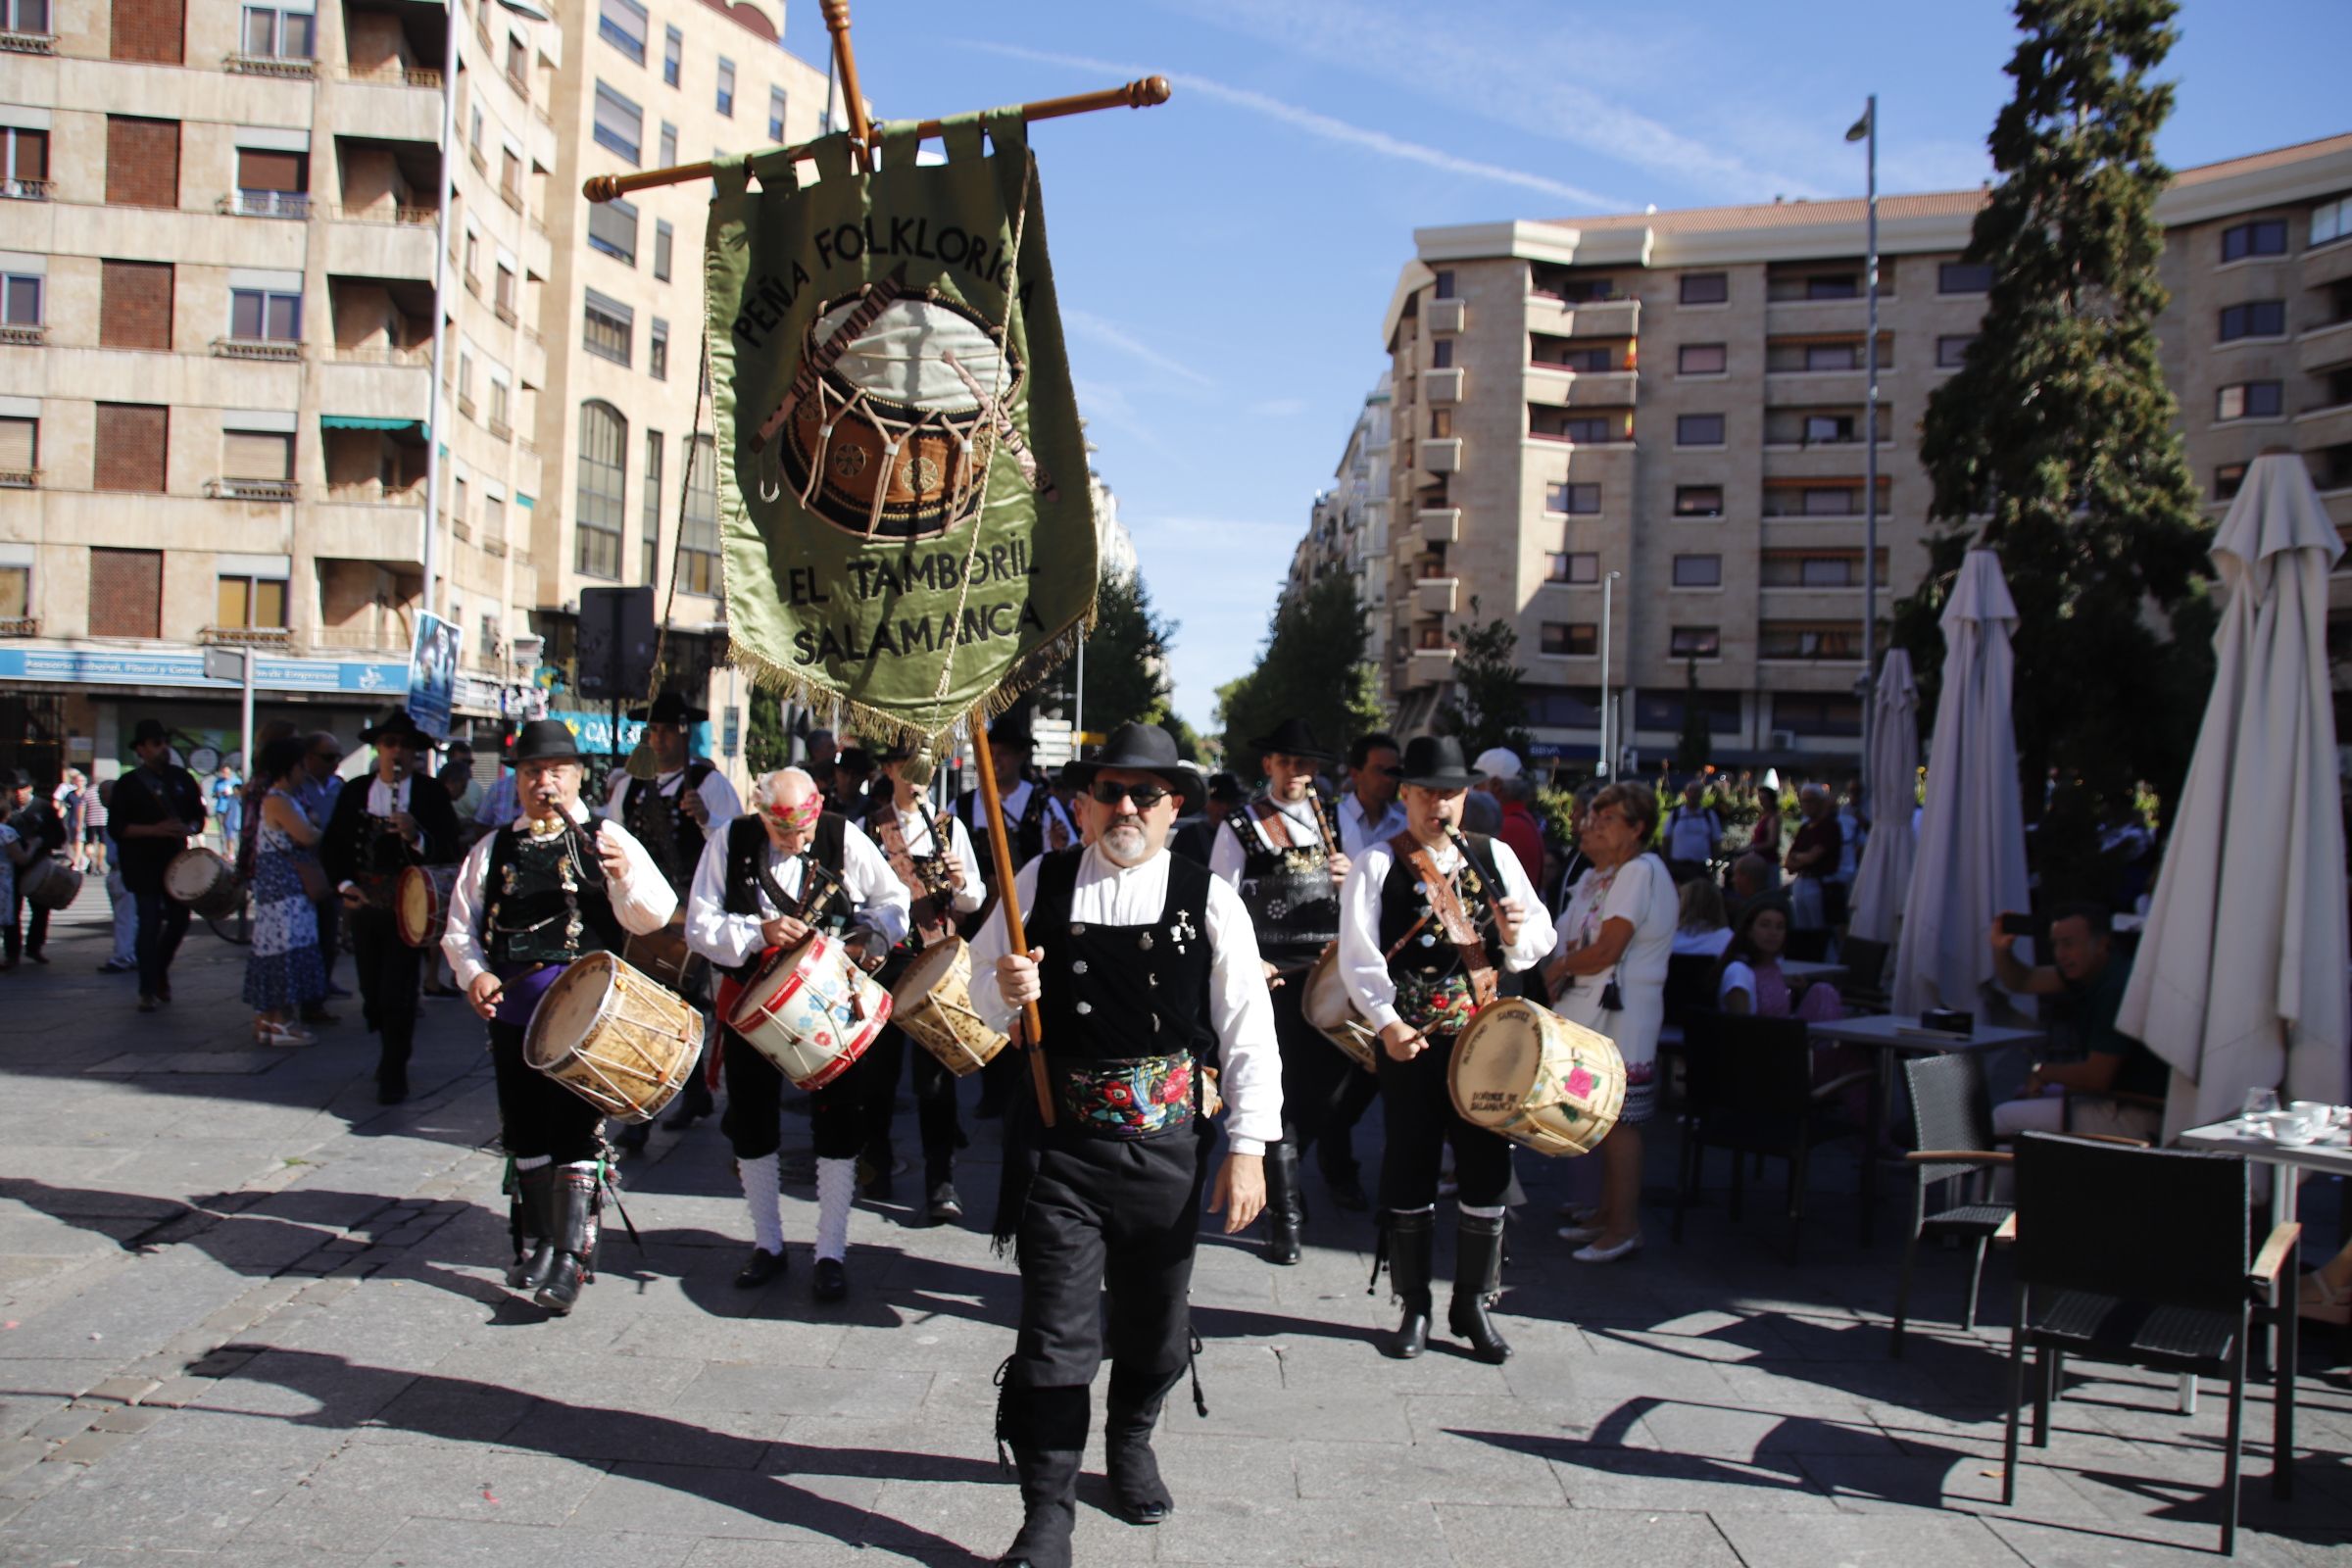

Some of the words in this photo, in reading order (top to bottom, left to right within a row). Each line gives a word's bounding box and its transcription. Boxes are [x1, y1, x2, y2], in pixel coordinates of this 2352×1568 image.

[732, 259, 810, 348] PEÑA
[789, 566, 829, 606] EL
[793, 598, 1045, 665] SALAMANCA
